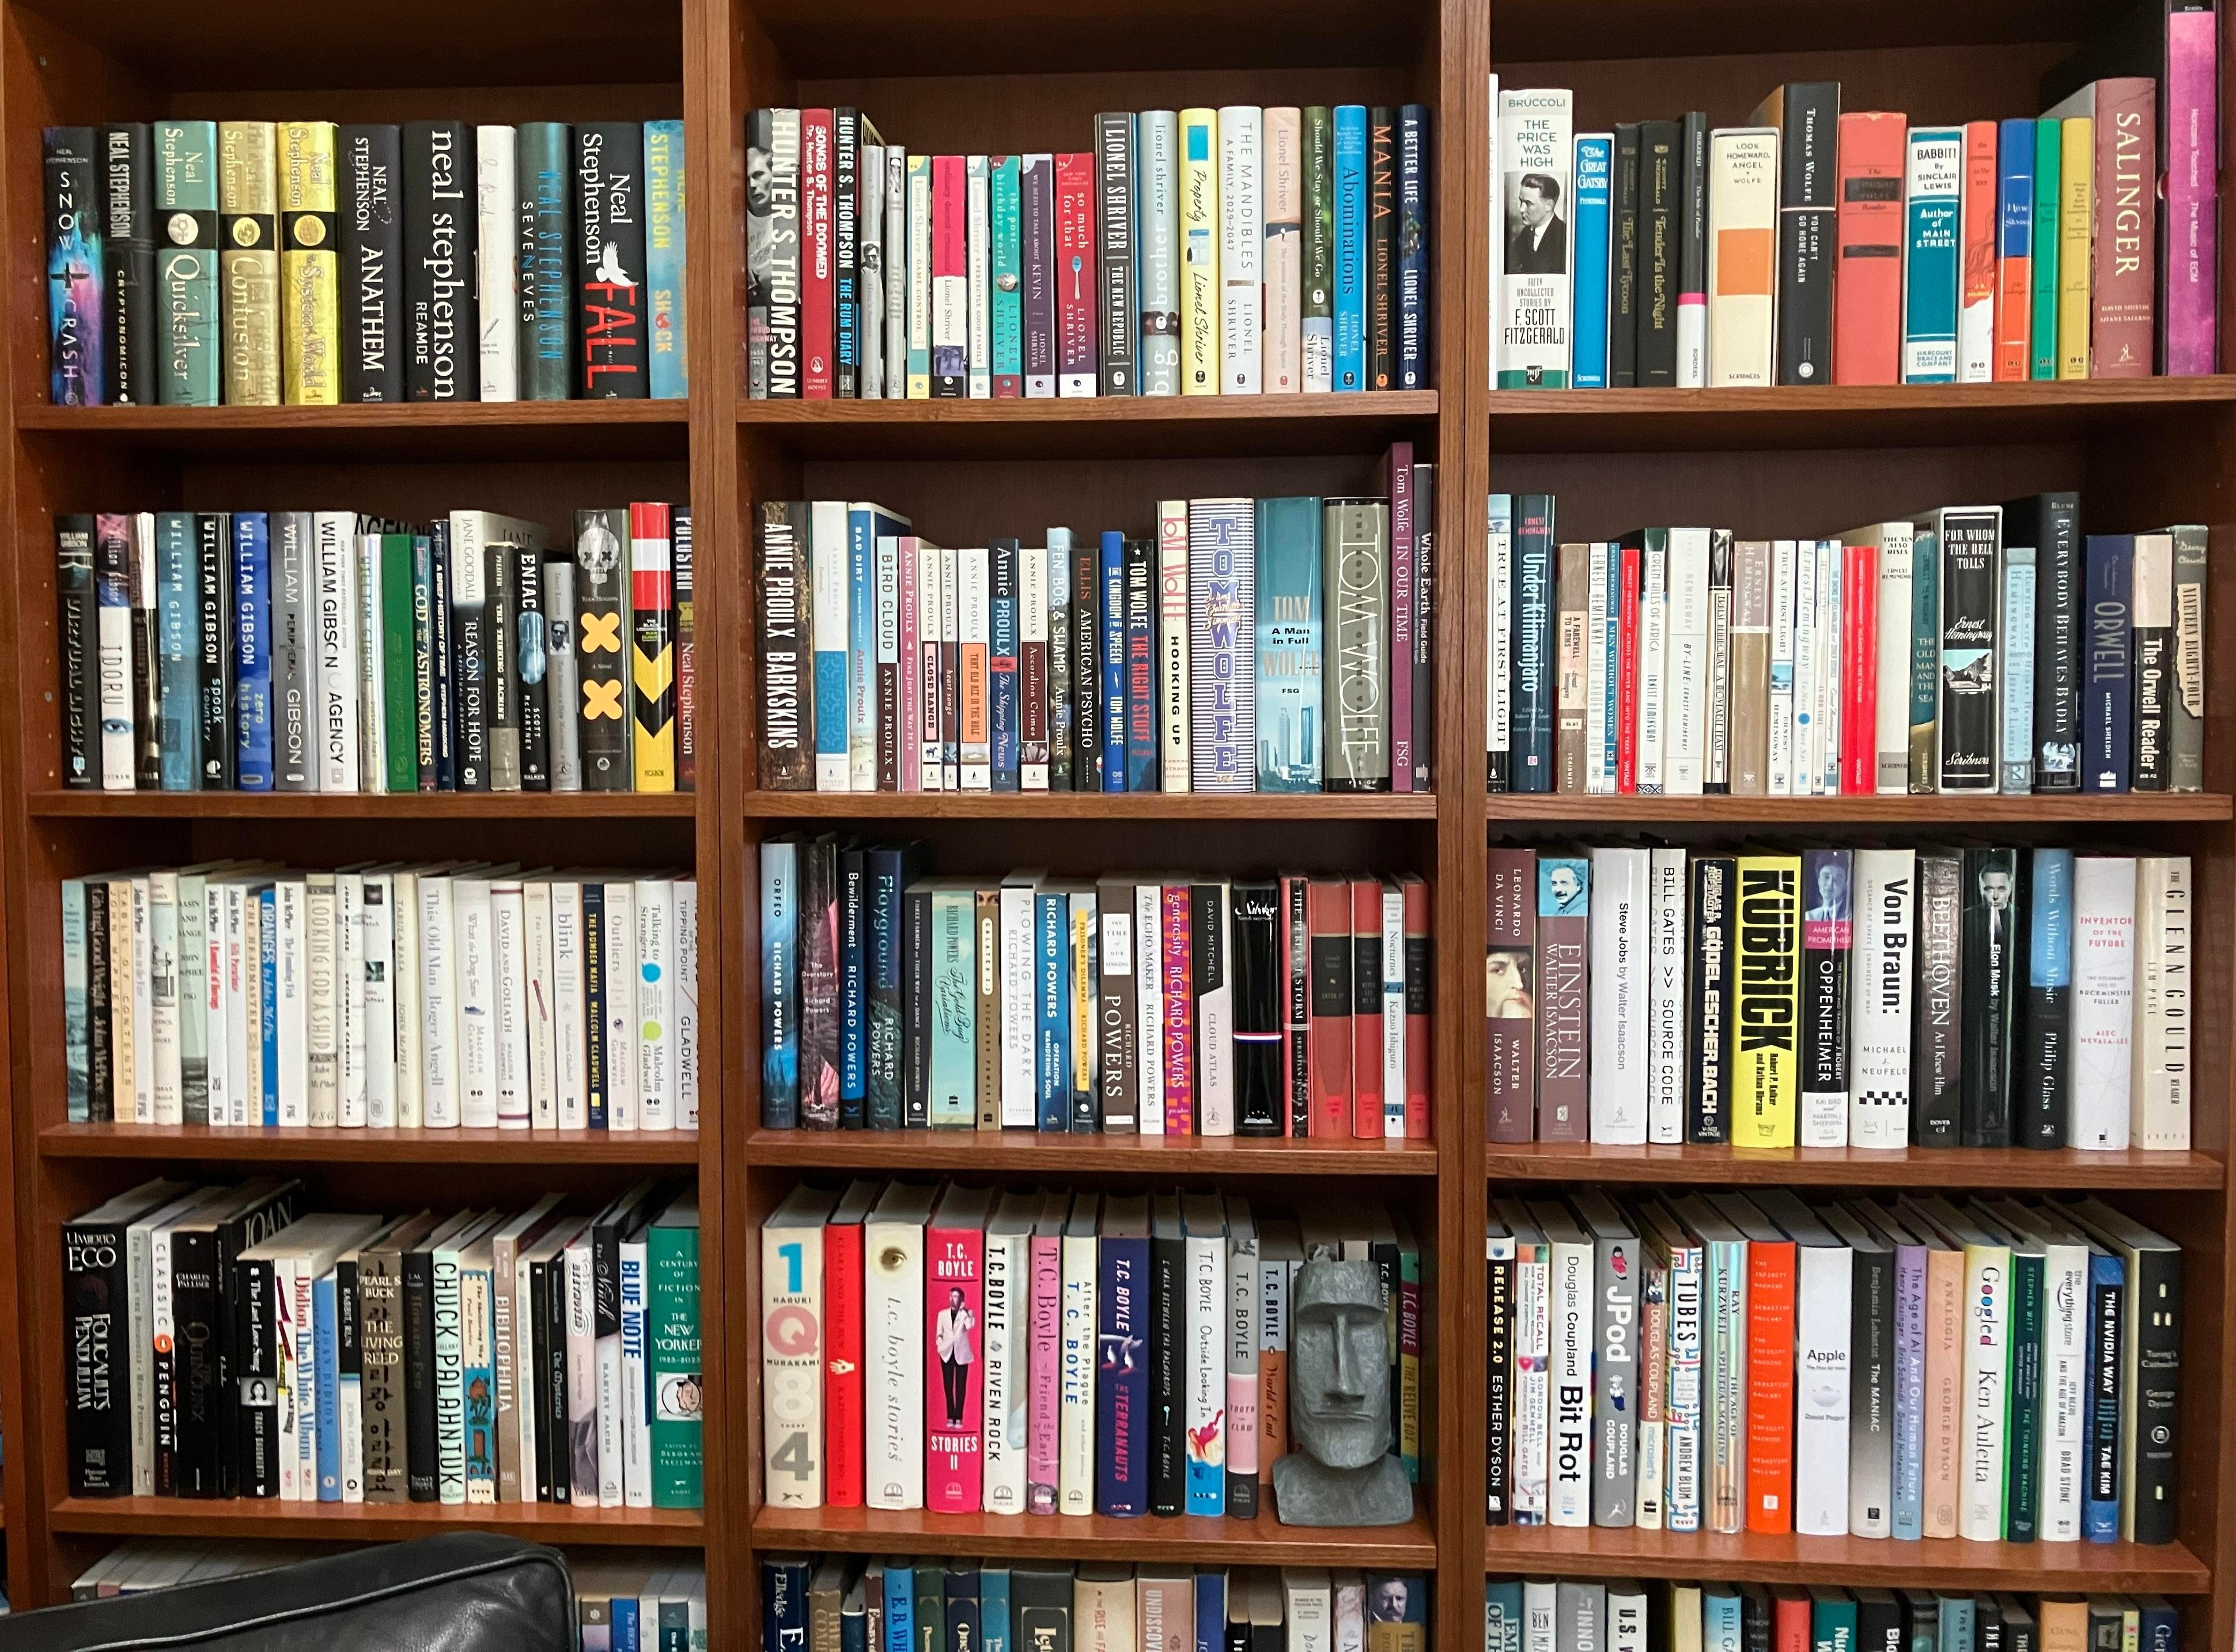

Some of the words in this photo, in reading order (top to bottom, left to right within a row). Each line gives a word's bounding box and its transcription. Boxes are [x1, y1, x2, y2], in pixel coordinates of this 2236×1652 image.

[1508, 99, 1565, 107] BRUCCOLI
[1524, 120, 1549, 129] THE
[109, 133, 130, 162] NEAL
[816, 126, 826, 172] SONGS
[1106, 129, 1126, 181] LIONEL
[1518, 133, 1557, 142] PRICE
[1523, 145, 1550, 154] WAS
[1806, 109, 1815, 164] THOMAS
[161, 128, 184, 205] Stephenson
[432, 130, 464, 200] neal
[771, 121, 797, 220] HUNTER
[816, 175, 827, 192] OF
[1374, 126, 1392, 220] MANIA
[1520, 158, 1553, 167] HIGH
[1577, 175, 1607, 189] GATSBY
[1580, 161, 1606, 173] GREAT
[1804, 168, 1814, 202] WOLFE
[109, 164, 131, 238] STEPHENSON
[580, 133, 603, 265] Stephenson
[816, 195, 827, 216] THE
[1107, 186, 1127, 250] SHRIVER
[1186, 169, 1208, 222] Property
[1241, 165, 1253, 270] MANDIBLES
[2116, 114, 2140, 276] SALINGER
[771, 229, 796, 251] S.
[816, 219, 828, 279] DOOMED
[1342, 166, 1355, 294] Abominations
[1916, 239, 1955, 247] STREET
[1923, 230, 1950, 238] MAIN
[523, 202, 535, 322] SEVENEVES
[1111, 266, 1122, 285] THE
[361, 245, 385, 372] ANATHEM
[424, 213, 466, 400] stephenson
[839, 278, 853, 299] THE
[1112, 289, 1123, 310] NEW
[1194, 272, 1208, 314] Lionel
[1517, 288, 1554, 296] UNCOLLECTED
[116, 270, 127, 390] CRYPTONOMICON
[165, 254, 200, 380] Quicksilver
[415, 302, 428, 365] REAMDE
[771, 257, 797, 394] THOMPSON
[840, 303, 853, 327] RUM
[1113, 313, 1124, 356] REPUBLIC
[1505, 327, 1564, 345] FITZGERALD
[1524, 309, 1556, 325] SCOTT
[840, 332, 853, 365] DIARY
[1194, 317, 1204, 364] Shriver
[203, 521, 215, 594] WILLIAM
[765, 523, 793, 570] ANNIE
[1421, 532, 1432, 573] Whole
[1945, 530, 1964, 542] FOR
[1966, 530, 1995, 540] WHOM
[1949, 544, 1968, 555] THE
[1972, 544, 1993, 555] BELL
[521, 554, 536, 608] ENIAC
[882, 555, 892, 594] BIRD
[997, 547, 1011, 597] Annie
[1522, 553, 1546, 601] Under
[1957, 558, 1985, 569] TOLLS
[2057, 519, 2070, 610] EVERYBODY
[766, 577, 796, 639] PROULX
[1421, 577, 1431, 614] Earth
[205, 602, 217, 663] GIBSON
[882, 600, 892, 649] CLOUD
[997, 600, 1009, 656] PROULX
[1080, 609, 1093, 685] AMERICAN
[1521, 603, 1546, 693] Kilimanjaro
[1945, 630, 1993, 641] Hemingway
[2056, 615, 2070, 682] BEHAVES
[2093, 602, 2125, 683] ORWELL
[101, 646, 123, 704] IDORU
[465, 621, 479, 682] REASON
[2144, 639, 2162, 662] The
[467, 686, 480, 716] FOR
[766, 652, 797, 749] BARKSKINS
[1171, 636, 1180, 716] HOOKING
[2143, 668, 2161, 713] Orwell
[329, 692, 345, 763] AGENCY
[992, 692, 1009, 732] Shipping
[1081, 691, 1093, 748] PSYCHO
[1172, 725, 1180, 745] UP
[2056, 686, 2069, 734] BADLY
[468, 720, 482, 762] HOPE
[997, 734, 1009, 768] News
[1946, 753, 1989, 766] Scribners
[2140, 720, 2160, 769] Reader
[1513, 869, 1521, 936] LEONARDO
[1664, 867, 1674, 902] BILL
[1884, 879, 1908, 925] Von
[312, 898, 330, 965] LOOKING
[848, 872, 859, 948] Bewilderment
[1167, 894, 1181, 957] generosity
[1620, 902, 1628, 933] Steve
[1663, 909, 1674, 955] GATES
[2080, 917, 2133, 925] INVENTOR
[2165, 890, 2185, 974] GLENN
[558, 914, 574, 959] blink
[611, 916, 619, 972] Outliers
[1021, 899, 1031, 981] PLOWING
[1619, 937, 1628, 963] Jobs
[1741, 870, 1795, 1052] KUBRICK
[1932, 898, 1950, 1025] BEETHOVEN
[774, 942, 782, 995] RICHARD
[1546, 944, 1558, 1000] WALTER
[1883, 933, 1906, 1014] Braun:
[1022, 993, 1031, 1025] THE
[1171, 967, 1183, 1028] RICHARD
[1558, 943, 1582, 1080] EINSTEIN
[1819, 961, 1833, 1081] OPPENHEIMER
[774, 1000, 783, 1050] POWERS
[1104, 996, 1122, 1097] POWERS
[1546, 1005, 1558, 1079] ISAACSON
[1662, 1000, 1674, 1059] SOURCE
[2165, 989, 2186, 1072] GOULD
[681, 1016, 692, 1099] GLADWELL
[1021, 1034, 1032, 1076] DARK
[1171, 1033, 1184, 1088] POWERS
[1662, 1064, 1673, 1104] CODE
[69, 1247, 116, 1271] ECO
[621, 1261, 640, 1305] BLUE
[939, 1260, 974, 1277] BOYLE
[1564, 1257, 1579, 1308] Douglas
[156, 1243, 167, 1326] CLASSIC
[365, 1288, 394, 1298] BUCK
[434, 1263, 457, 1336] CHUCK
[1116, 1286, 1130, 1330] BOYLE
[1493, 1267, 1504, 1334] RELEASE
[1975, 1267, 2000, 1346] Googled
[2105, 1292, 2115, 1317] THE
[622, 1310, 641, 1359] NOTE
[664, 1324, 694, 1336] NEW
[1606, 1286, 1632, 1362] JPod
[1678, 1280, 1697, 1341] TUBES
[495, 1296, 512, 1412] BIBLIOPHILIA
[881, 1335, 905, 1388] boyle
[1493, 1340, 1503, 1363] 2.0
[1567, 1313, 1578, 1376] Coupland
[1807, 1349, 1847, 1363] Apple
[2104, 1320, 2114, 1368] NVIDIA
[158, 1362, 171, 1446] PENGUIN
[989, 1360, 1001, 1411] RIVEN
[1493, 1376, 1503, 1431] ESTHER
[1560, 1386, 1583, 1424] Bit
[1978, 1368, 1997, 1408] Ken
[2103, 1371, 2113, 1393] WAY
[436, 1355, 464, 1485] PALAHNIUK
[887, 1394, 902, 1462] stories
[1870, 1383, 1881, 1432] MANIAC
[932, 1436, 977, 1452] STORIES
[989, 1417, 1000, 1461] ROCK
[1114, 1390, 1129, 1481] TERRANAUTS
[1559, 1434, 1582, 1482] Rot
[1975, 1415, 1995, 1483] Auletta
[1491, 1437, 1501, 1486] DYSON
[1533, 1611, 1548, 1628] BEN
